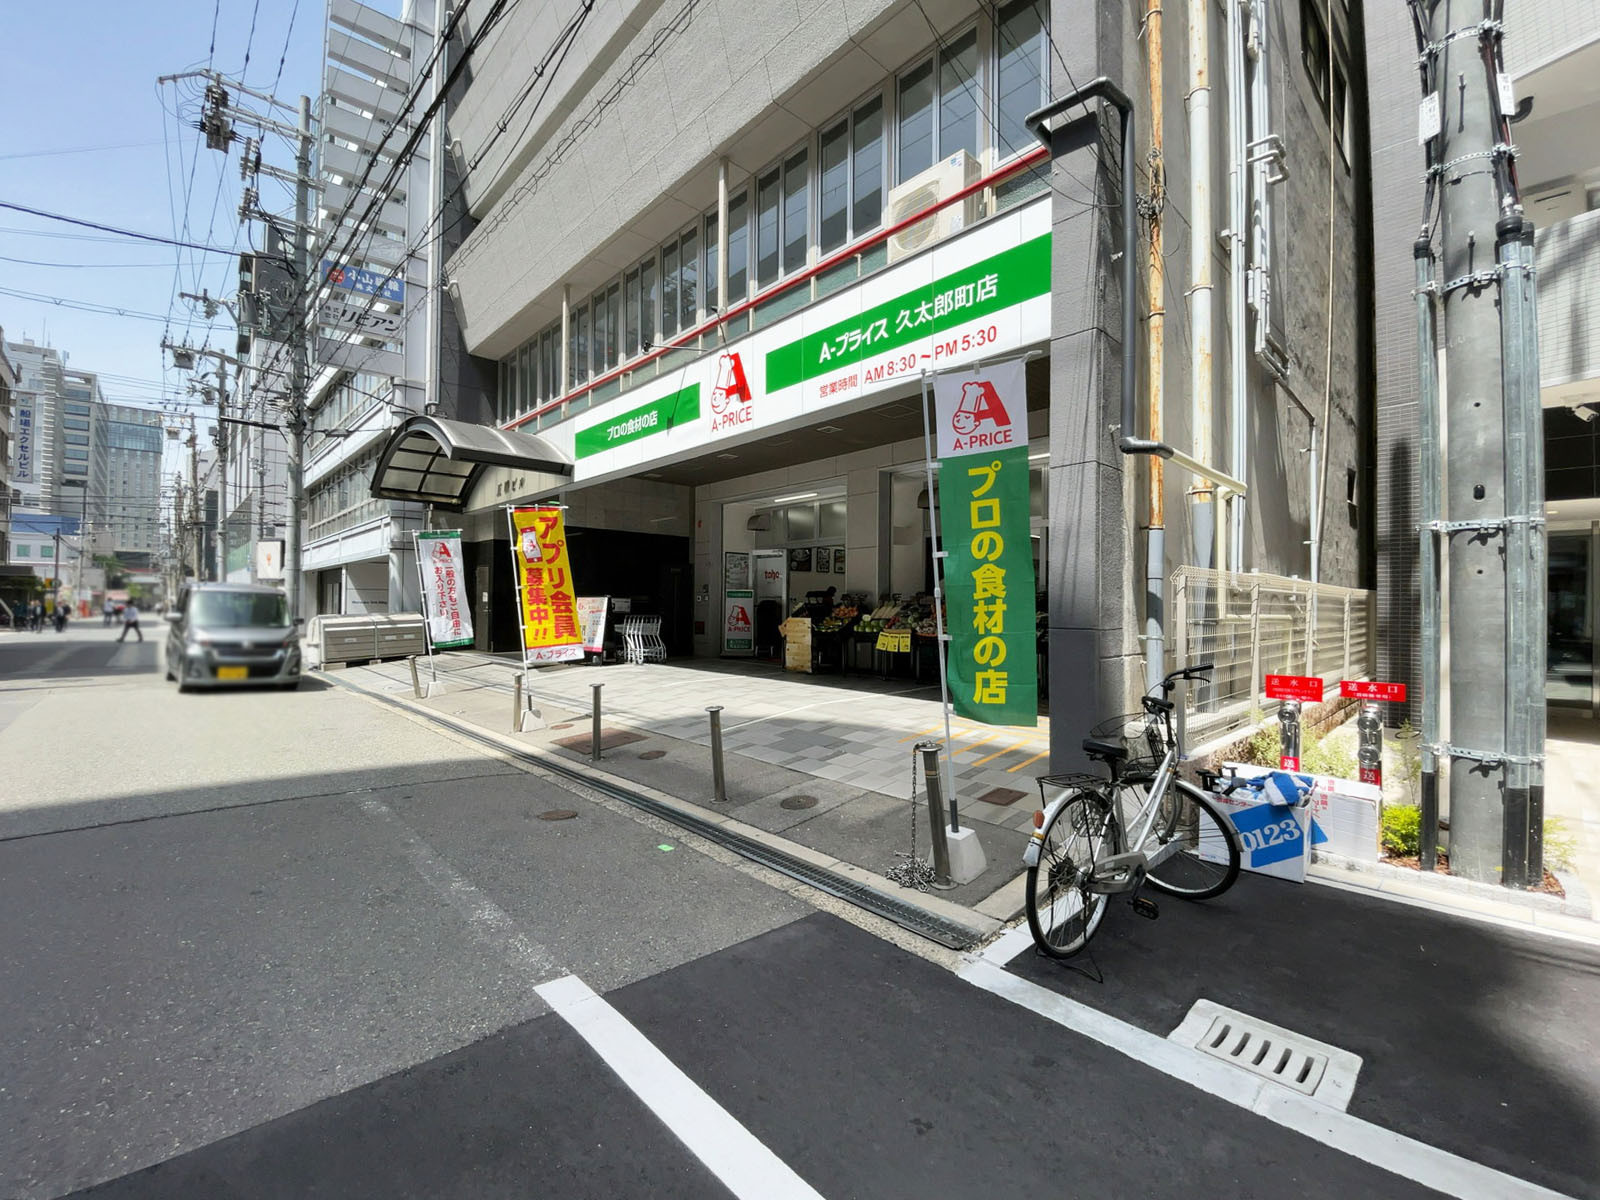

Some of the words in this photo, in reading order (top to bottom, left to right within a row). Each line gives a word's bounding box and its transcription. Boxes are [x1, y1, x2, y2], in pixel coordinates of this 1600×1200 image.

[895, 273, 999, 333] 久太郎町店
[819, 374, 858, 398] 営業時間
[887, 354, 916, 376] 8:30
[962, 325, 997, 352] 5:30
[606, 410, 659, 441] プロの食材の店
[711, 405, 753, 432] A-PRICE
[952, 428, 1013, 451] A-PRICE
[434, 566, 449, 617] お入り下さい
[444, 565, 461, 637] 一般の方もご自由に
[539, 516, 577, 639] アプリ会員
[968, 460, 1009, 705] プロの食材の店
[1239, 819, 1301, 851] 0123
